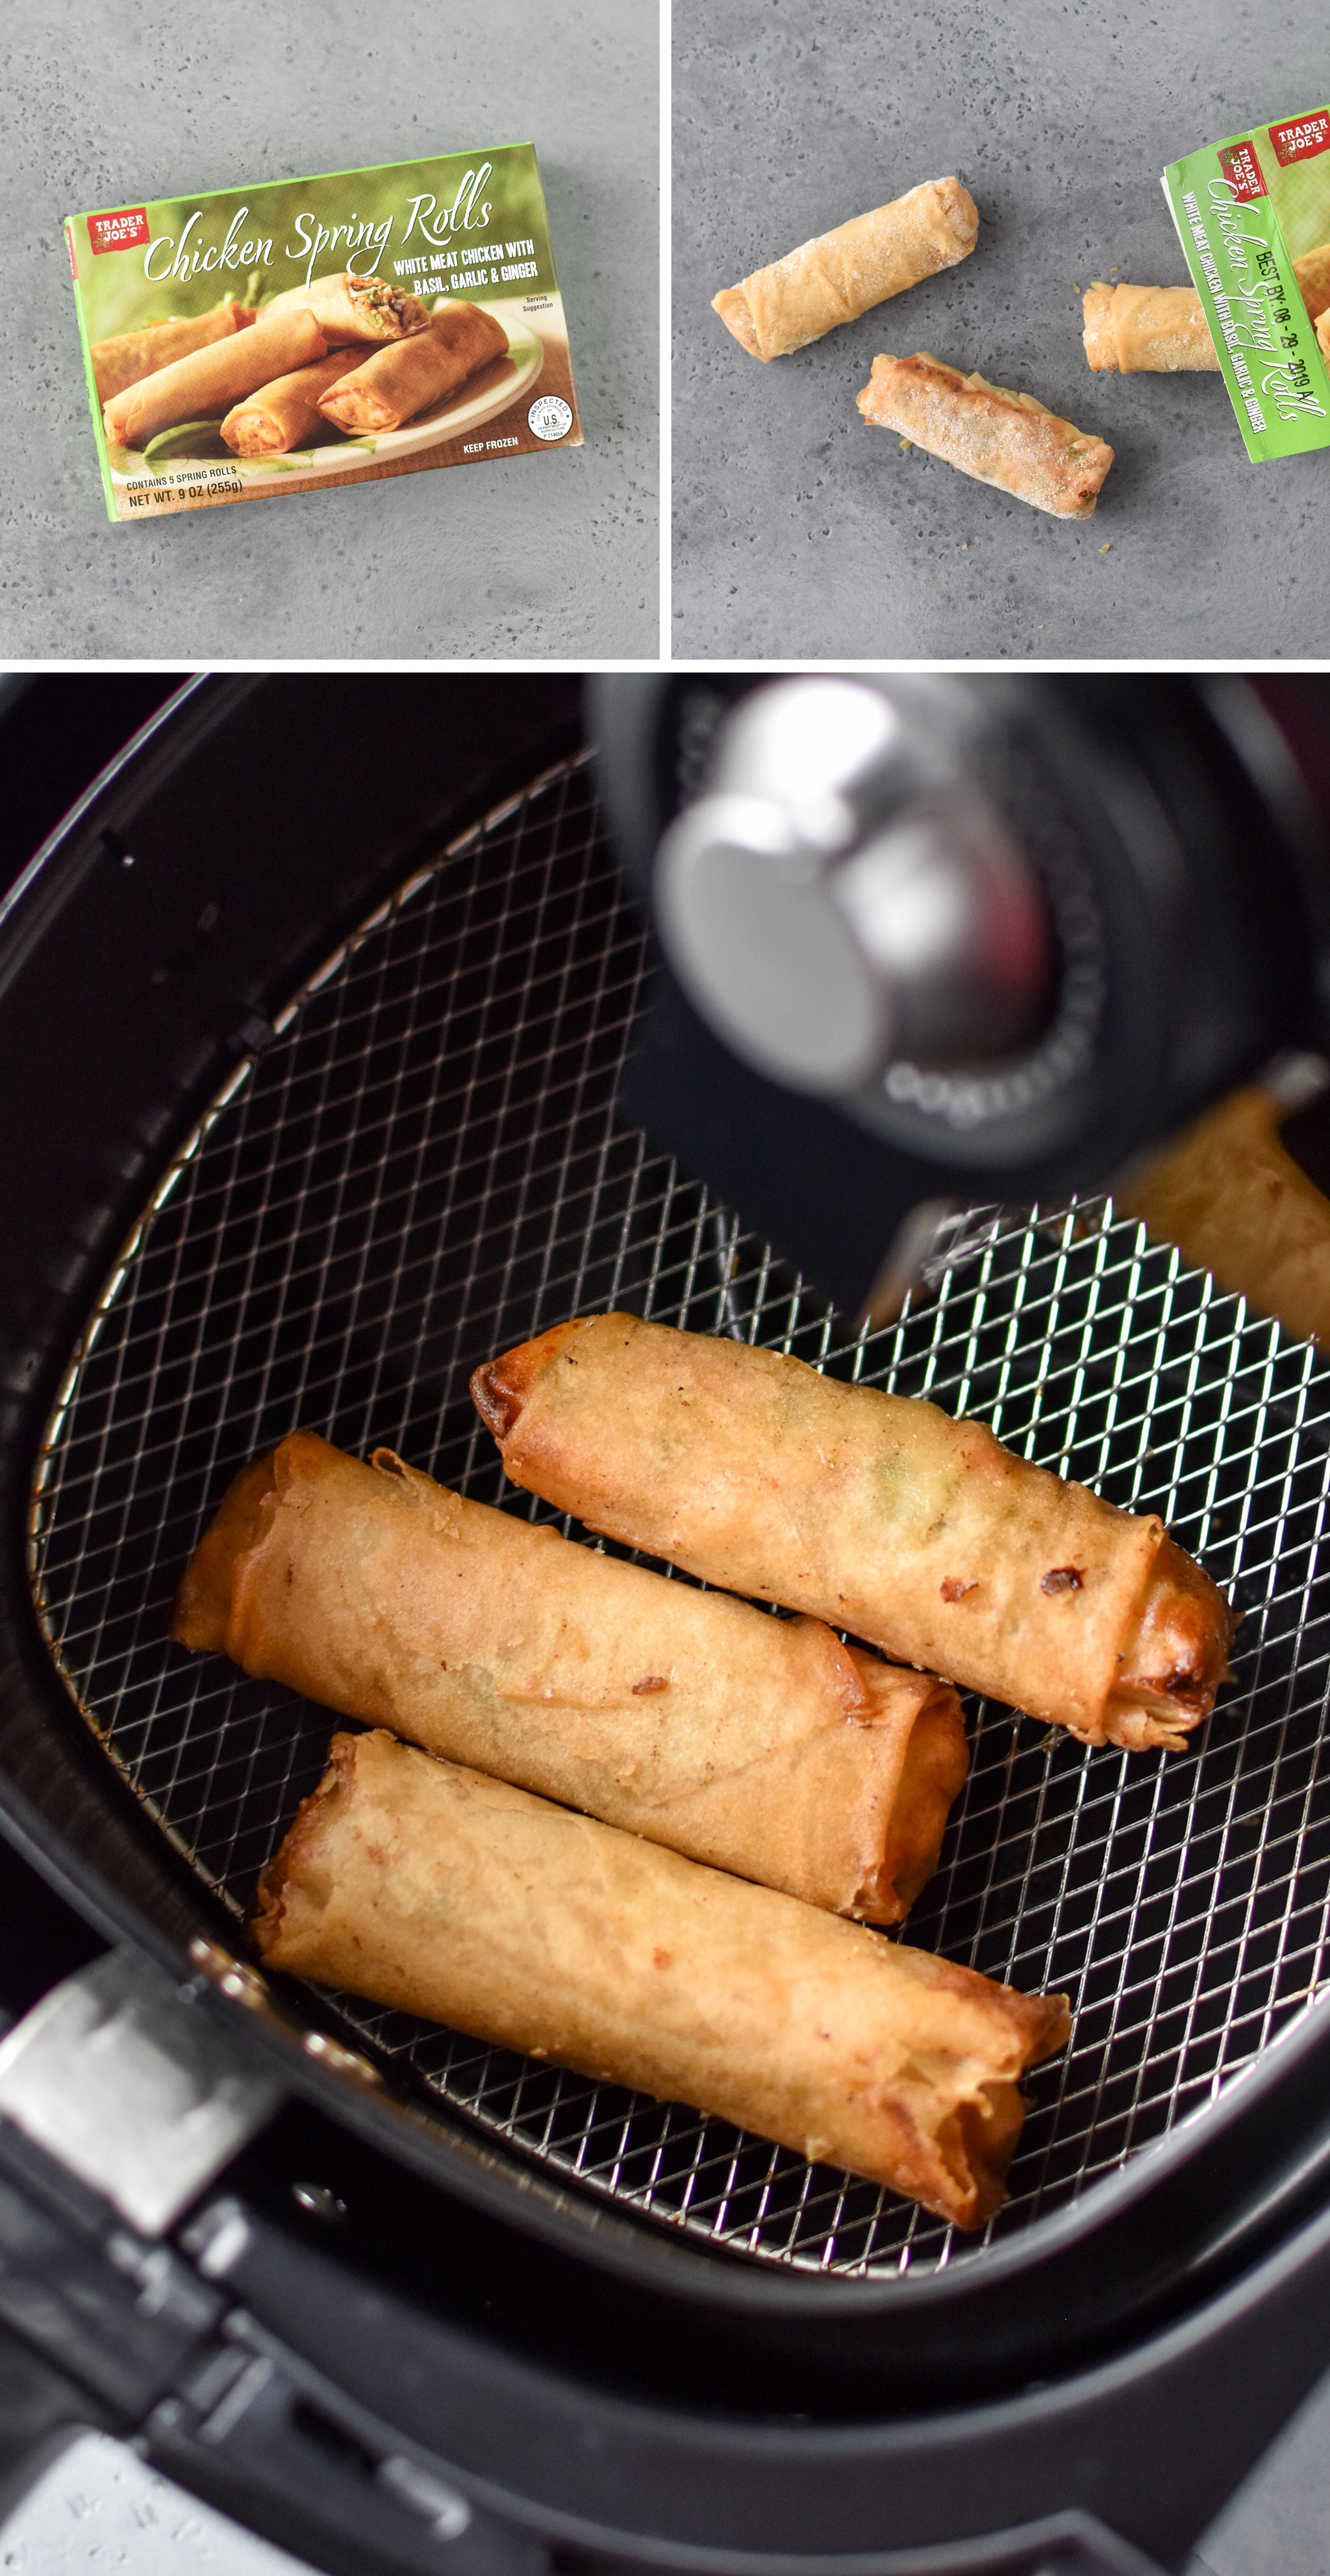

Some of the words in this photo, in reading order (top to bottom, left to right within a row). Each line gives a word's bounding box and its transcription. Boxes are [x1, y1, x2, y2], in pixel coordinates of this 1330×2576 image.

[1278, 118, 1329, 142] TRADER
[1288, 132, 1324, 151] JOE'S
[1231, 158, 1248, 190] JOE'S
[1239, 149, 1261, 195] TRADER
[1182, 191, 1201, 226] WHITE
[95, 215, 144, 232] TRADER
[103, 227, 138, 241] JOE'S
[144, 206, 274, 282] Chicken
[286, 213, 393, 288] Spring
[401, 162, 493, 246] Rolls
[1208, 179, 1268, 272] Chicken
[1191, 224, 1211, 253] MEAT
[394, 257, 429, 277] WHITE
[430, 251, 458, 271] MEAT
[461, 244, 505, 265] CHICKEN
[505, 239, 535, 258] WITH
[1256, 251, 1280, 282] BEST
[414, 277, 450, 296] BASIL,
[451, 269, 488, 290] GARLIC
[491, 268, 499, 283] &
[501, 261, 538, 281] GINGER
[1199, 252, 1223, 294] CHICKEN
[523, 302, 553, 312] Suggestion
[527, 295, 547, 303] Serving
[1213, 292, 1232, 322] WITH
[1267, 284, 1286, 307] BY:
[1225, 278, 1278, 351] Spring
[1273, 308, 1291, 323] 08
[1220, 319, 1239, 355] BASIL,
[1280, 333, 1298, 349] 29
[1230, 353, 1253, 389] GARLIC
[1288, 359, 1310, 388] 2019
[1241, 388, 1255, 399] &
[1259, 358, 1327, 421] Rolls
[1297, 391, 1313, 400] A
[531, 398, 568, 418] INSPECTED
[539, 404, 564, 418] WHOLESOMENESS
[544, 414, 559, 425] U.S.
[1244, 397, 1266, 434] GINGER
[463, 442, 484, 453] KEEP
[486, 437, 518, 450] FROZEN
[127, 477, 167, 491] CONTAINS
[177, 471, 207, 482] SPRING
[210, 466, 236, 477] ROLLS
[129, 494, 150, 507] NET
[154, 490, 175, 503] WT.
[179, 488, 185, 499] 9
[189, 486, 204, 498] OZ
[207, 479, 243, 497] (255g)
